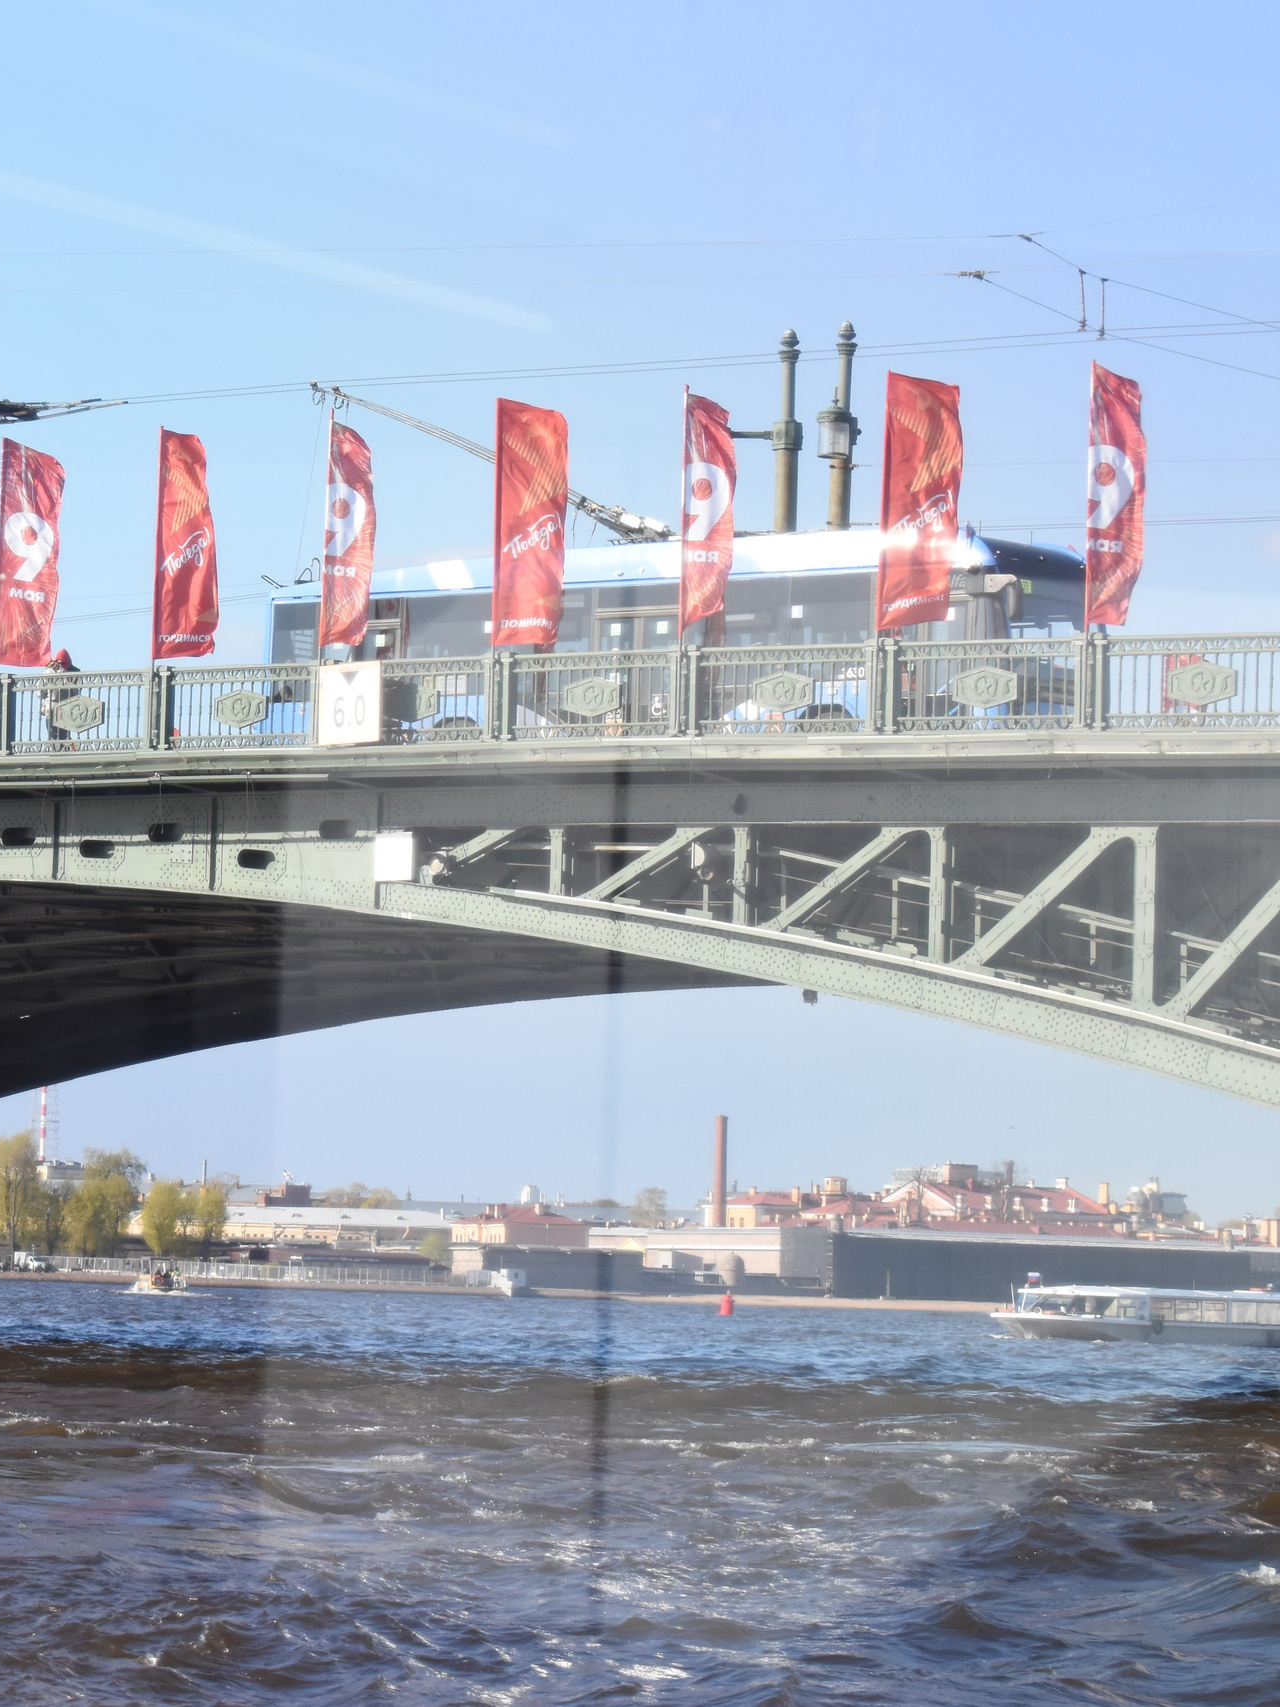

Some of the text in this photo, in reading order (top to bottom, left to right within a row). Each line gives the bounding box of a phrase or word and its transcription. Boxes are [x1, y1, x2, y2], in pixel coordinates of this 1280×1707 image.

[324, 482, 366, 556] 9
[682, 462, 730, 541] 9
[1087, 444, 1135, 530] 9
[4, 512, 54, 582] 9
[160, 526, 210, 577] Победа!
[503, 510, 562, 559] Победа!
[333, 694, 366, 729] 6.0
